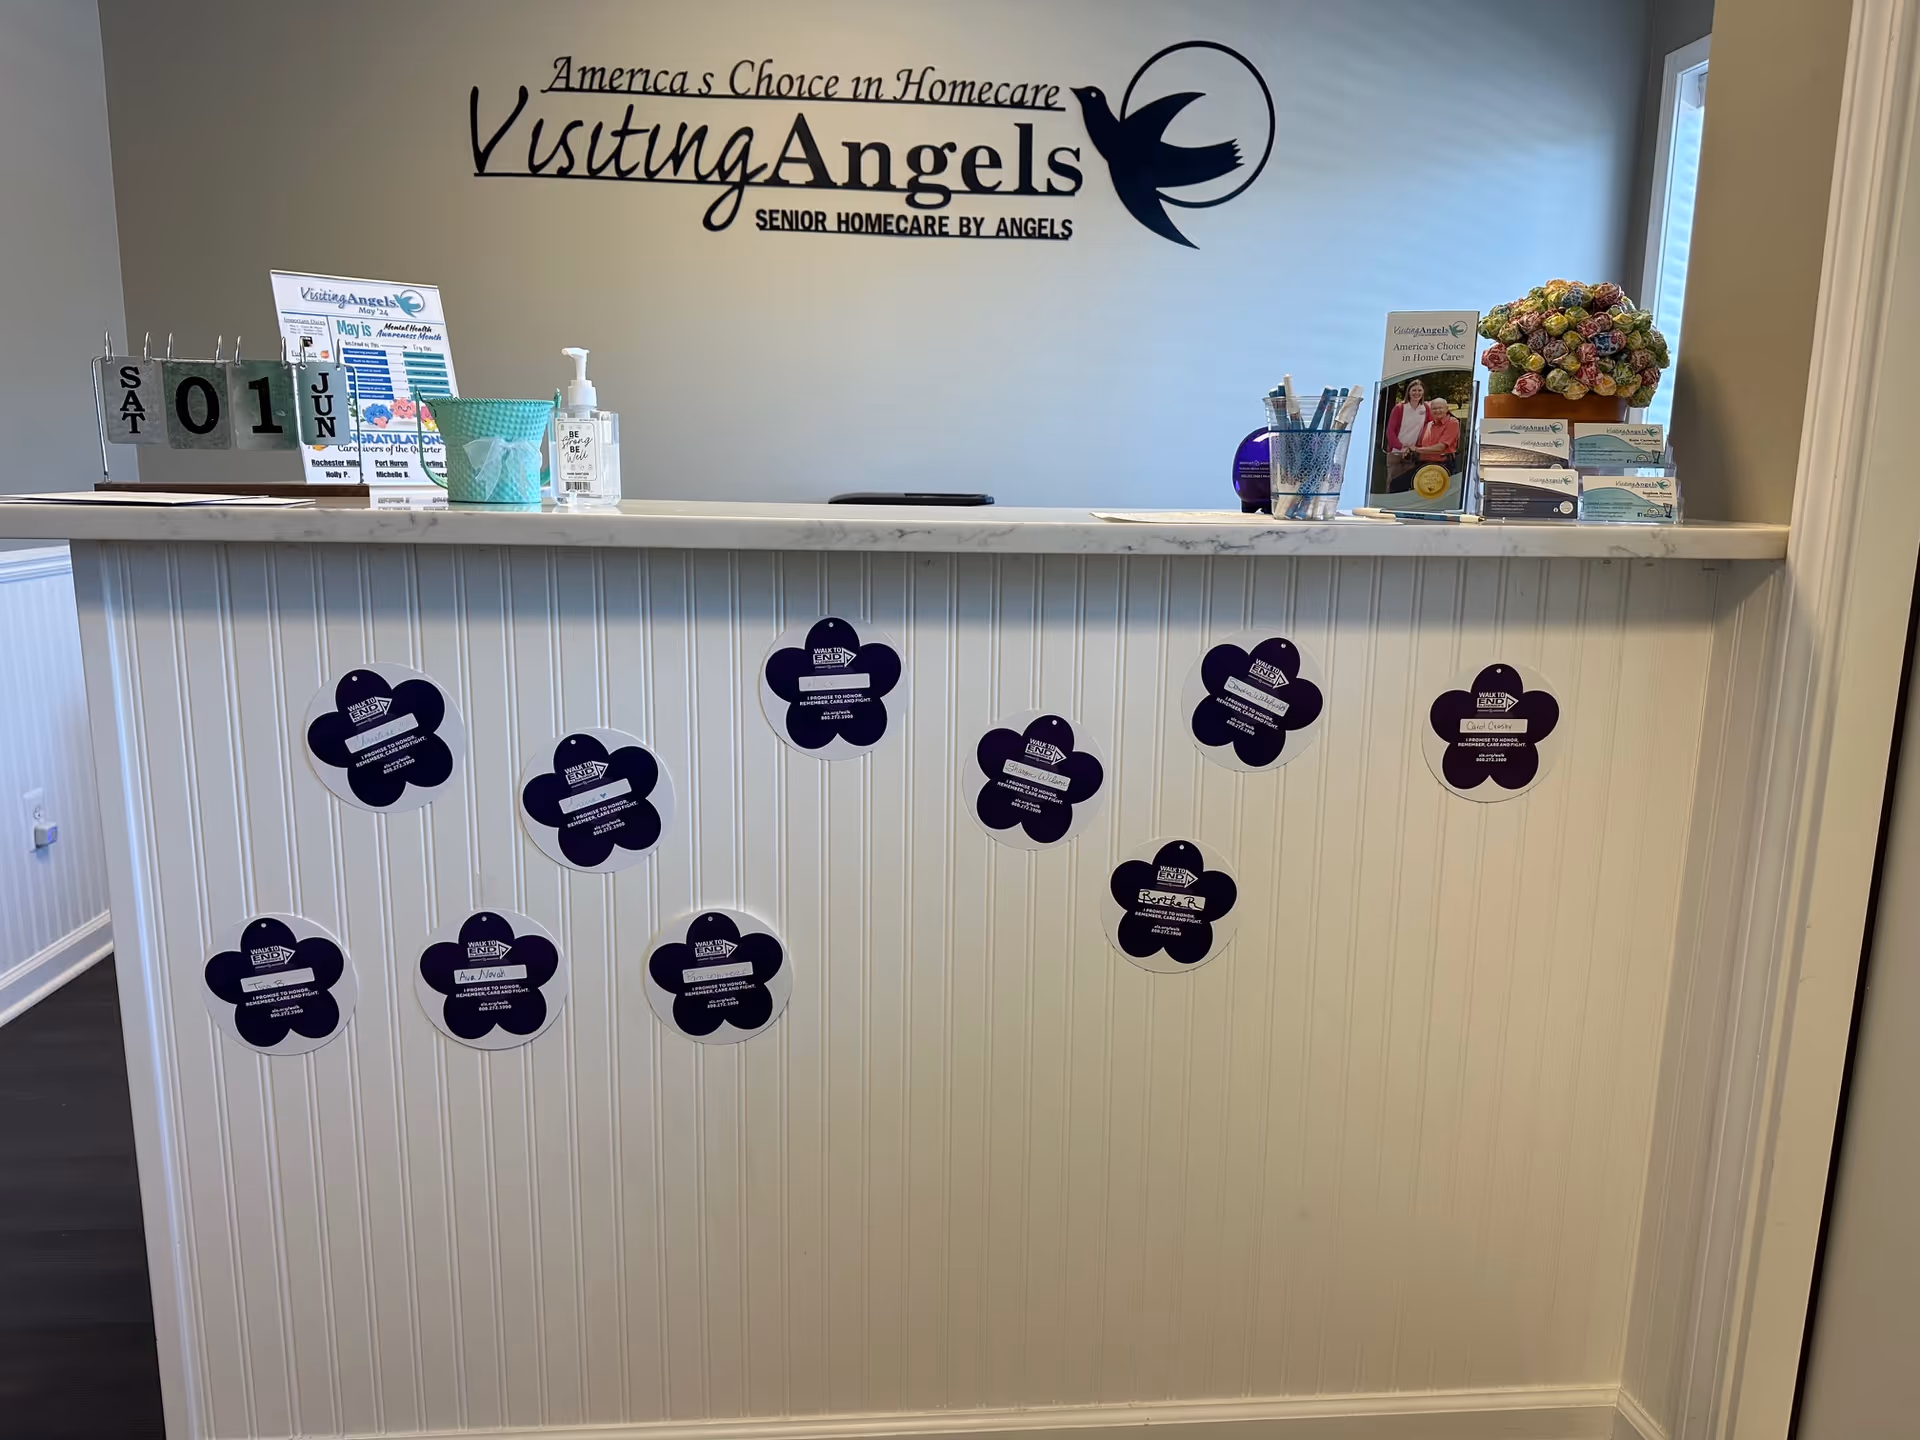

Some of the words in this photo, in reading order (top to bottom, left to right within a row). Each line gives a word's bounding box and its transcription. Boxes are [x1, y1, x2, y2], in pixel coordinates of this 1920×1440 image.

[729, 58, 839, 98] Choice
[851, 75, 884, 100] in
[893, 66, 1060, 108] Homecare
[756, 209, 828, 232] SENIOR
[836, 211, 950, 237] HOMECARE
[959, 215, 985, 238] BY
[997, 217, 1074, 240] ANGELS
[358, 307, 375, 316] May
[336, 320, 360, 339] May
[360, 321, 372, 337] is
[384, 322, 409, 332] Mental
[409, 324, 432, 333] Health
[376, 329, 416, 340] Awareness
[417, 333, 442, 341] Month
[1393, 343, 1435, 351] America's
[1436, 342, 1466, 350] Choice
[1402, 354, 1410, 362] in
[1413, 354, 1439, 362] Home
[120, 366, 146, 434] SAT
[311, 372, 336, 438] JUN
[568, 430, 579, 438] BE
[337, 445, 384, 453] Careivers
[385, 444, 394, 456] of
[395, 444, 408, 453] the
[569, 445, 580, 453] BE
[311, 459, 345, 467] Rochester
[375, 459, 389, 467] Port
[325, 471, 341, 479] Holly
[1255, 658, 1272, 670] WALK
[1252, 664, 1277, 680] END
[347, 700, 367, 712] WALK
[365, 696, 376, 704] TO
[350, 702, 380, 719] END
[1466, 720, 1485, 730] Carol
[1029, 738, 1047, 748] WALK
[364, 746, 387, 758] PROMISE
[384, 747, 399, 756] CARE
[1027, 744, 1053, 756] END
[564, 764, 583, 775] WALK
[582, 760, 592, 768] TO
[566, 766, 595, 781] END
[1038, 772, 1068, 786] Wilson
[1009, 780, 1030, 789] PROMISE
[1025, 789, 1038, 797] CARE
[1159, 871, 1184, 880] END
[250, 947, 270, 955] WALK
[468, 946, 497, 954] END
[696, 945, 724, 953] END
[252, 951, 281, 961] END
[457, 970, 476, 981] Ava
